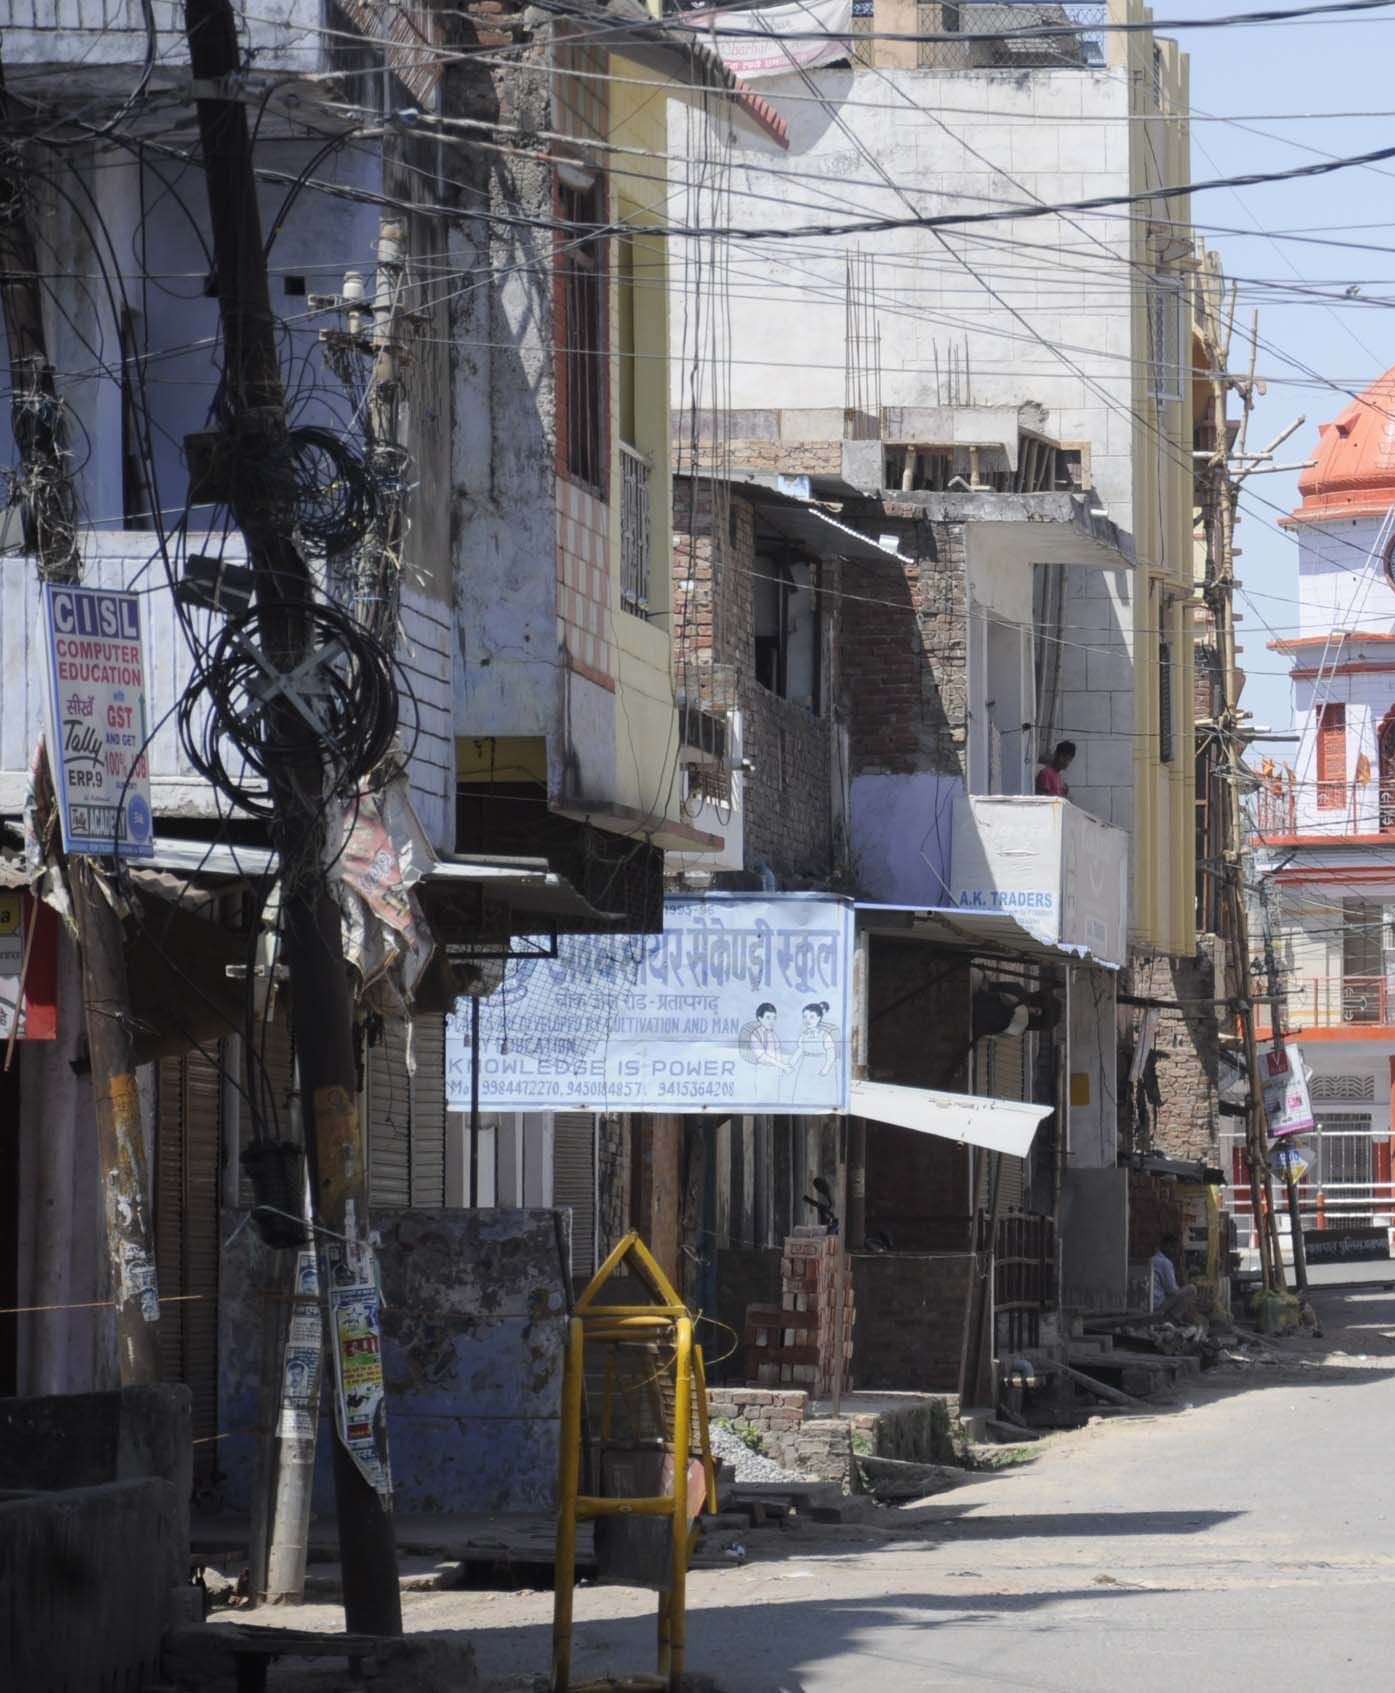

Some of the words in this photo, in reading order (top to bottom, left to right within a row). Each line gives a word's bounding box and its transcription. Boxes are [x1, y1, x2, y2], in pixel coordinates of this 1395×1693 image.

[54, 594, 138, 639] CISL
[56, 639, 139, 664] COMPUTER
[58, 660, 141, 687] EDUCATION
[107, 704, 133, 729] GST
[63, 720, 104, 768] Tally
[121, 734, 136, 746] GET
[960, 890, 986, 906] A.K.
[990, 890, 1053, 908] TRADERS
[776, 928, 841, 994] स्कूल
[682, 1018, 708, 1033] AND
[711, 1018, 740, 1034] MAN
[449, 1058, 605, 1076] KNOWLEDGE
[618, 1060, 640, 1076] IS
[652, 1060, 736, 1077] POWER
